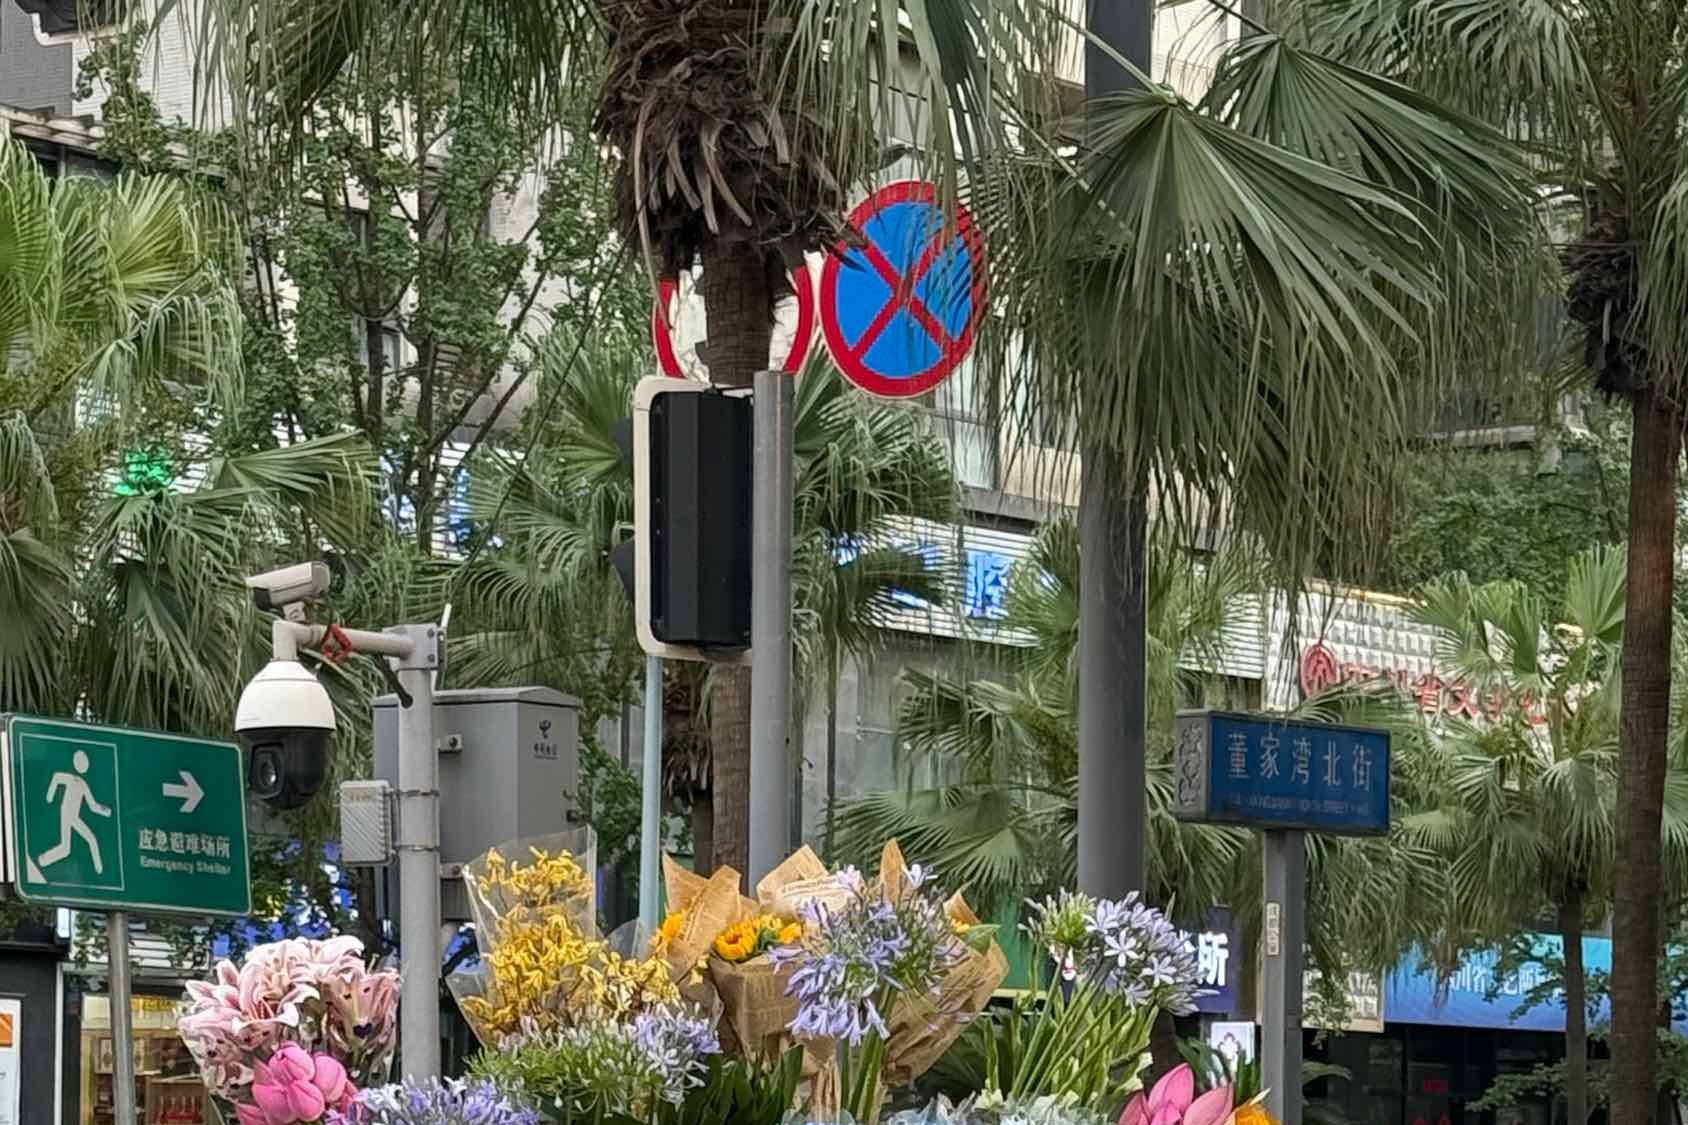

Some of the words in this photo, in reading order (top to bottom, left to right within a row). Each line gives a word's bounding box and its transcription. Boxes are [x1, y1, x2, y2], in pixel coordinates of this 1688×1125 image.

[1227, 730, 1373, 792] 董家湾北街
